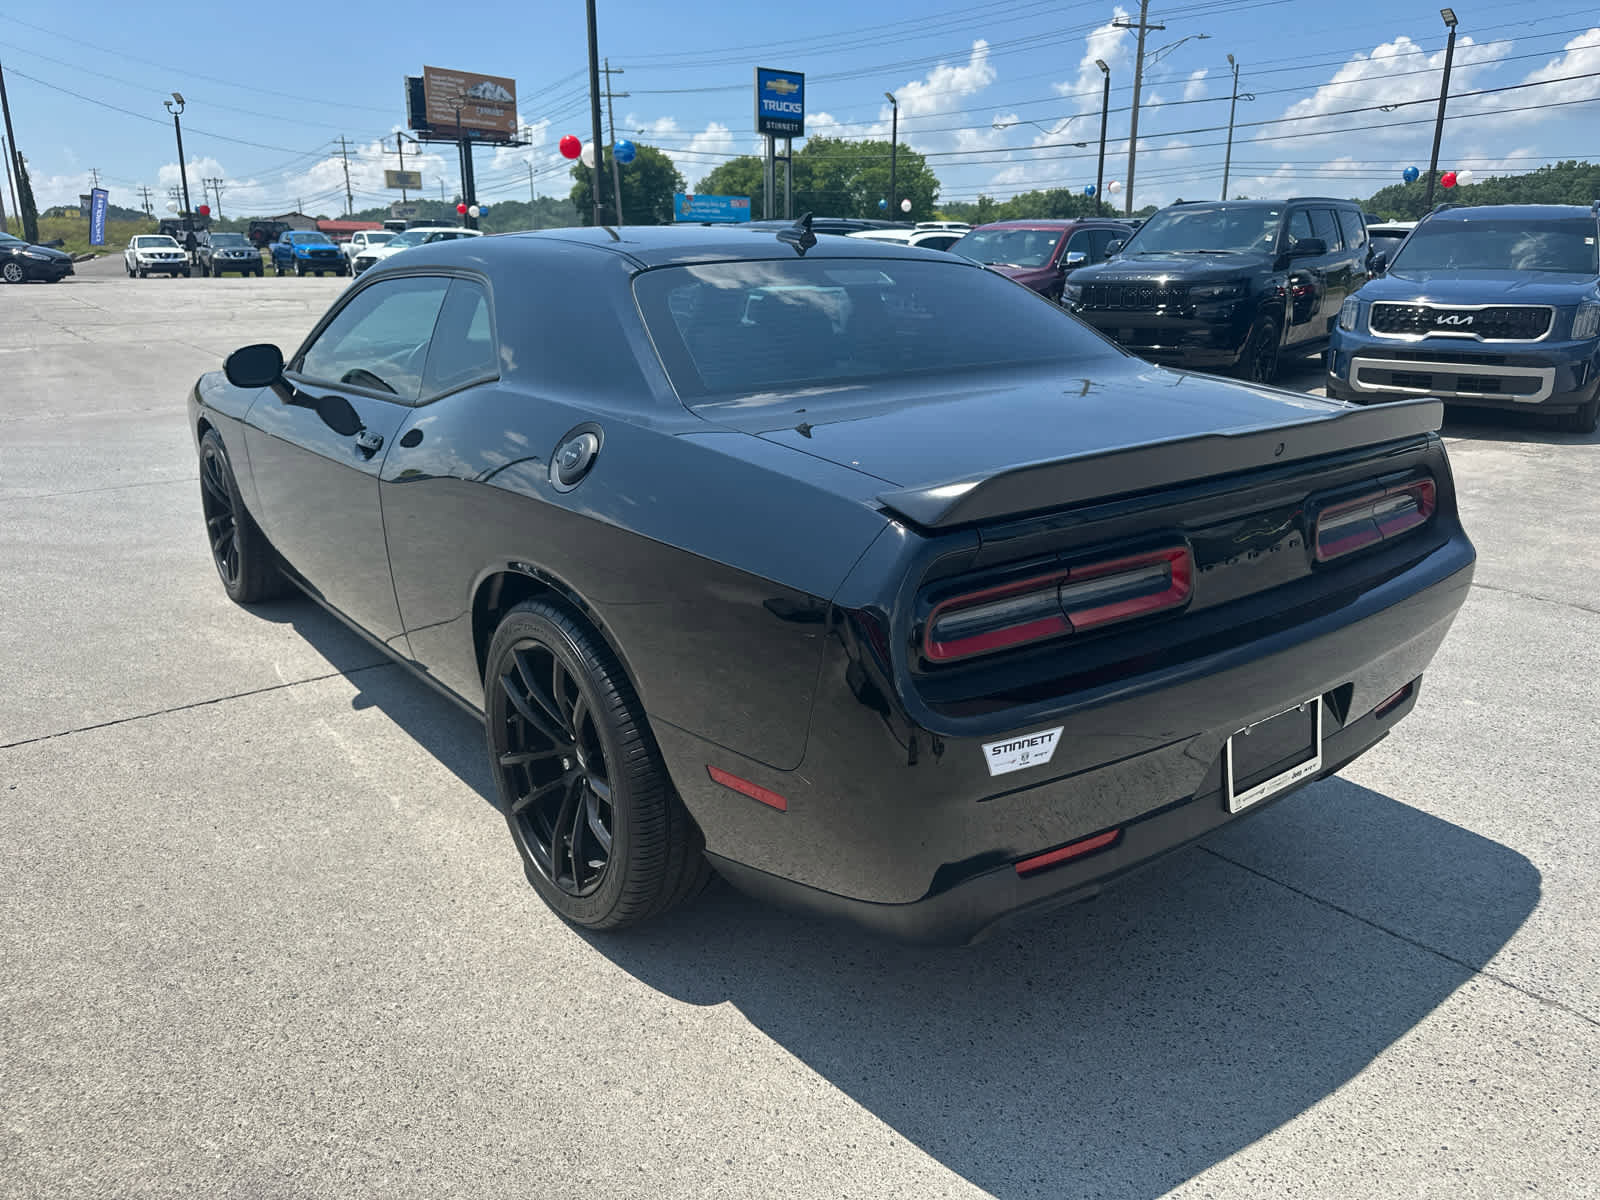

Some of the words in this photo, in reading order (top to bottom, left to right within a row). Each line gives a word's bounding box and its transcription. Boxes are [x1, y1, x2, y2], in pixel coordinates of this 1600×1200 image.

[763, 99, 802, 114] TRUCKS
[766, 121, 799, 132] STINNETT
[991, 732, 1055, 756] STINNETT
